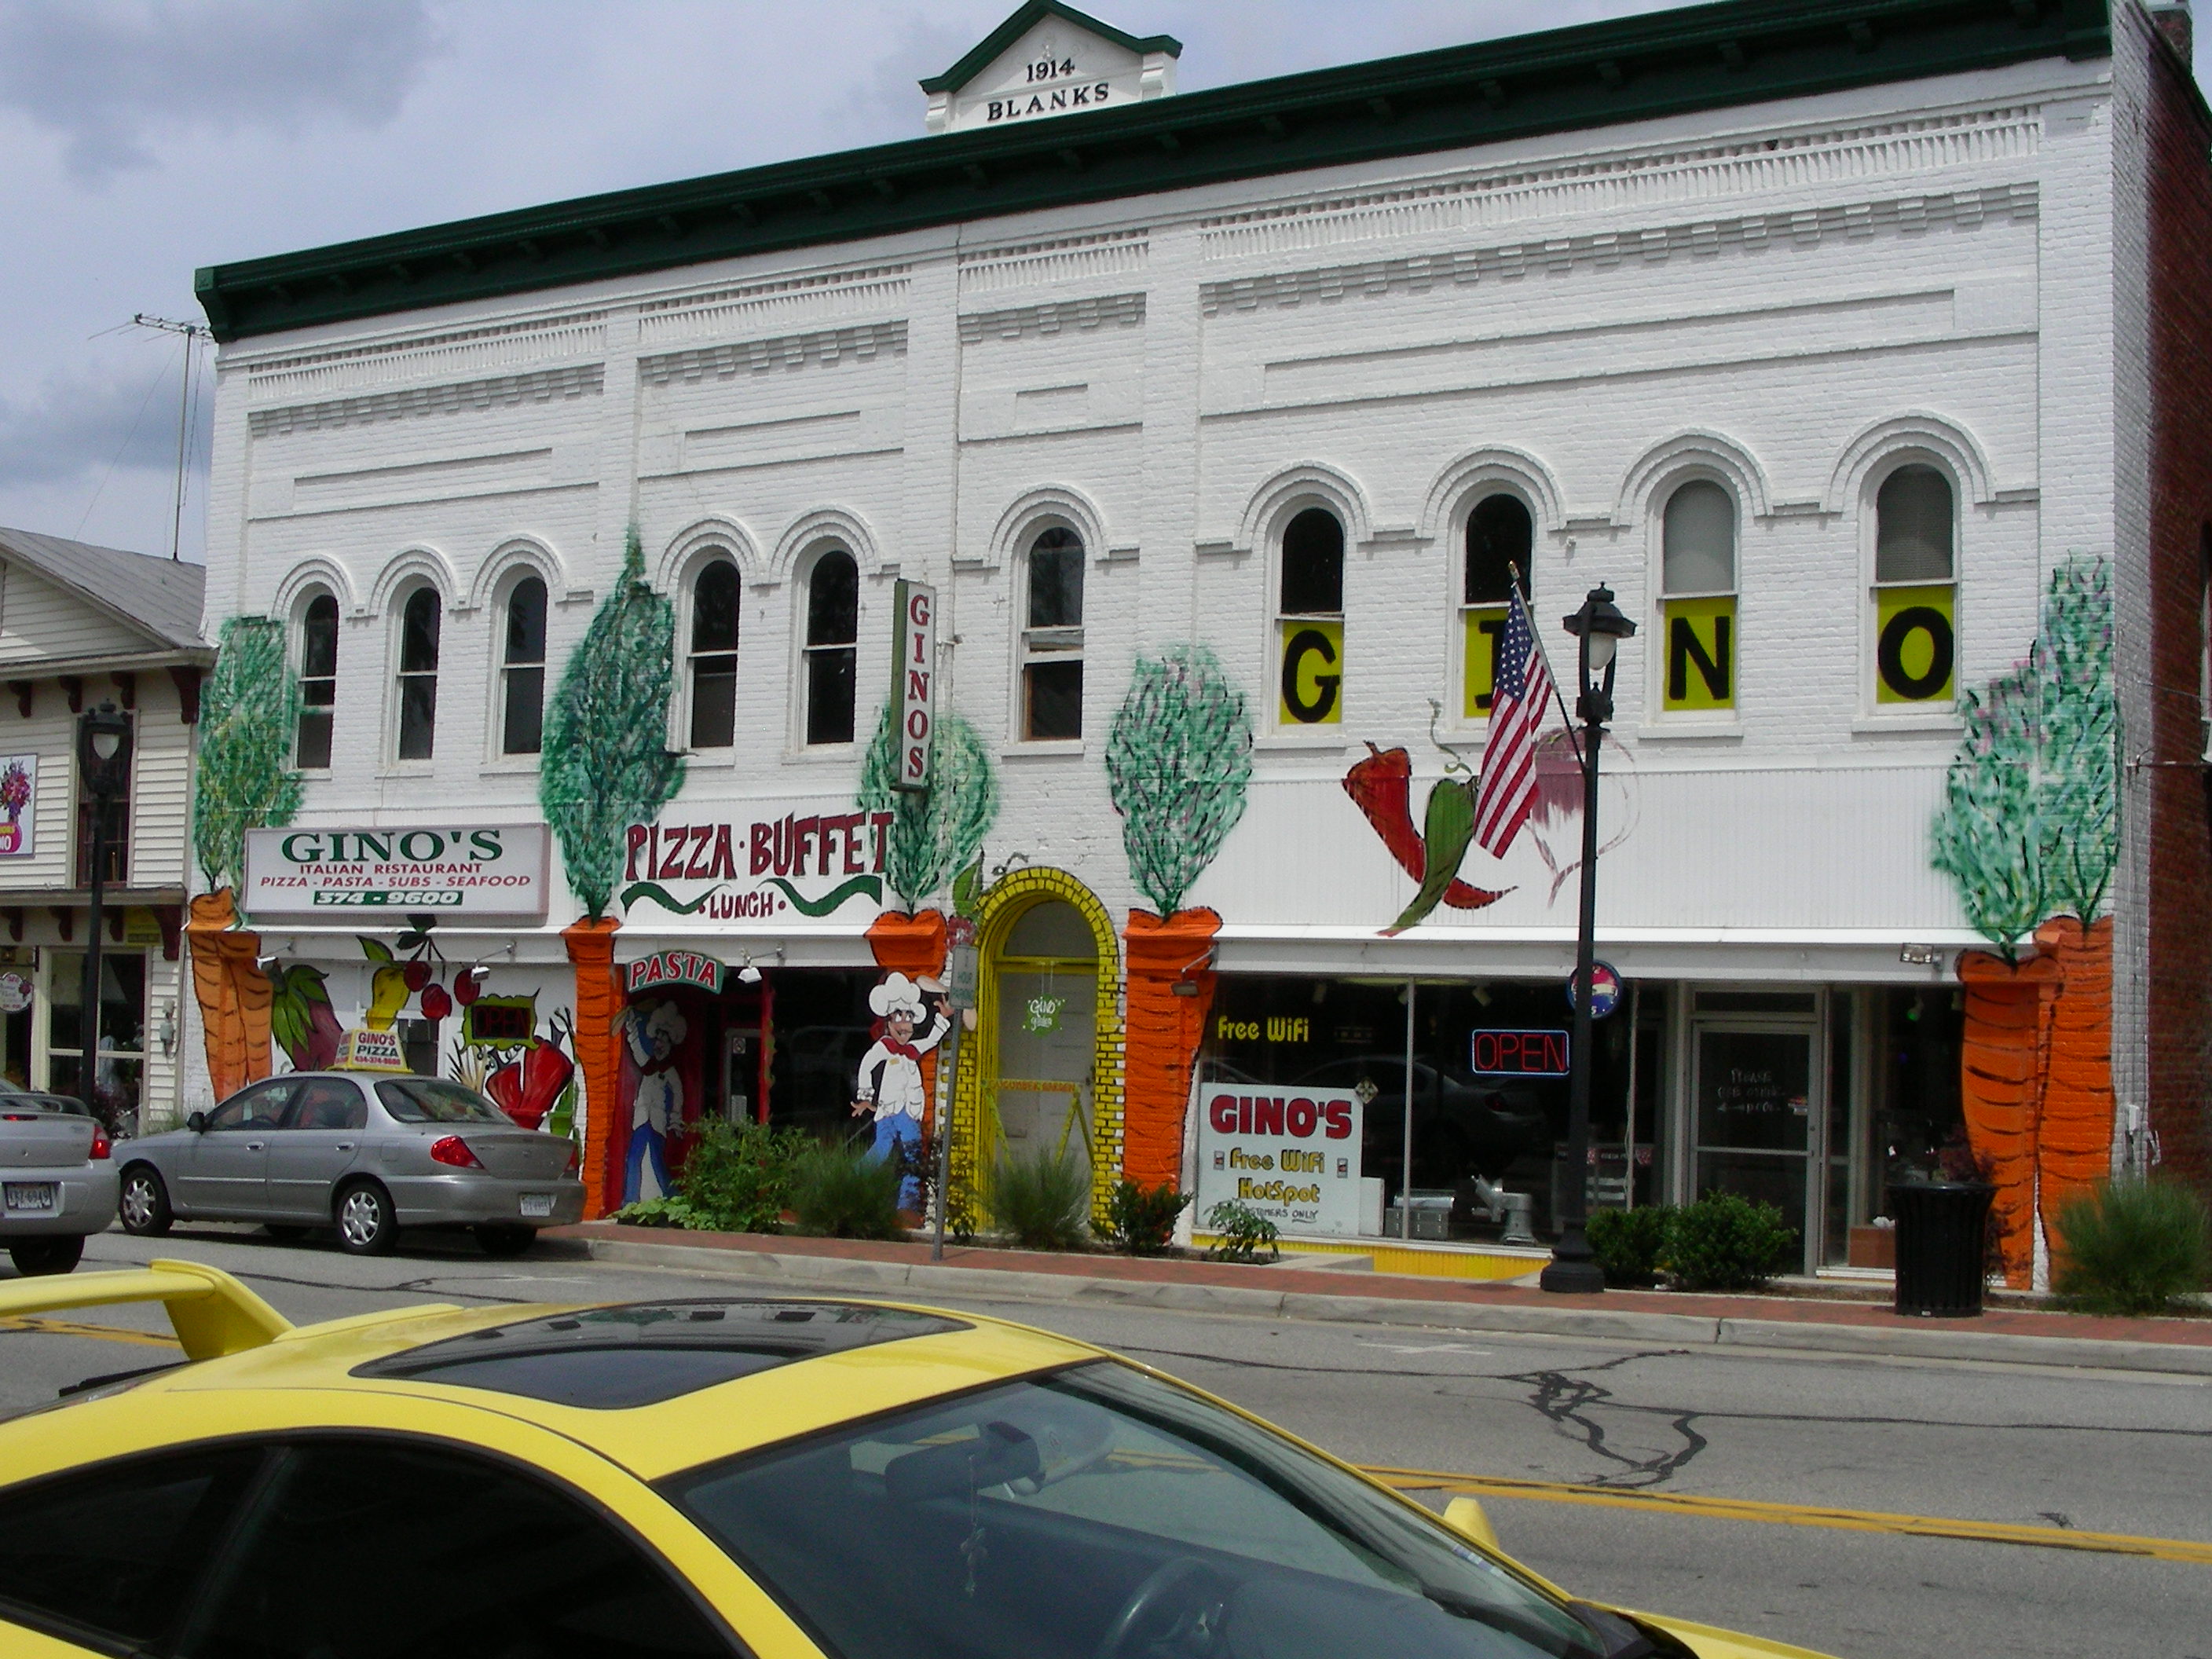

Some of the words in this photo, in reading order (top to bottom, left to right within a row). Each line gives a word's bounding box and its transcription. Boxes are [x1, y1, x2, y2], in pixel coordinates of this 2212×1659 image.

[1026, 57, 1076, 82] 1914
[987, 82, 1110, 122] BLANKS
[907, 594, 930, 778] GINOS
[281, 830, 504, 863] GINO'S
[625, 820, 738, 881] PIZZA
[750, 811, 894, 877] BUFFET
[261, 877, 308, 887] PIZZA
[323, 877, 373, 887] PASTA
[388, 876, 431, 887] SUBS
[446, 876, 531, 887] SEAFOOD
[300, 864, 364, 874] ITALIAN
[374, 863, 482, 874] RESTAURANT
[709, 891, 775, 919] LUNCH
[629, 950, 717, 991] PASTA
[473, 1005, 531, 1038] OPEN
[1218, 1015, 1260, 1040] Free
[1267, 1016, 1309, 1042] WiFi
[357, 1031, 396, 1046] GINO'S
[357, 1045, 399, 1057] PIZZA
[1474, 1033, 1567, 1073] OPEN
[1210, 1094, 1353, 1140] GINO'S
[1230, 1147, 1274, 1170] Free
[1280, 1149, 1325, 1174] WiFi
[1238, 1177, 1320, 1207] HotSpot
[1291, 1210, 1319, 1219] ONLY
